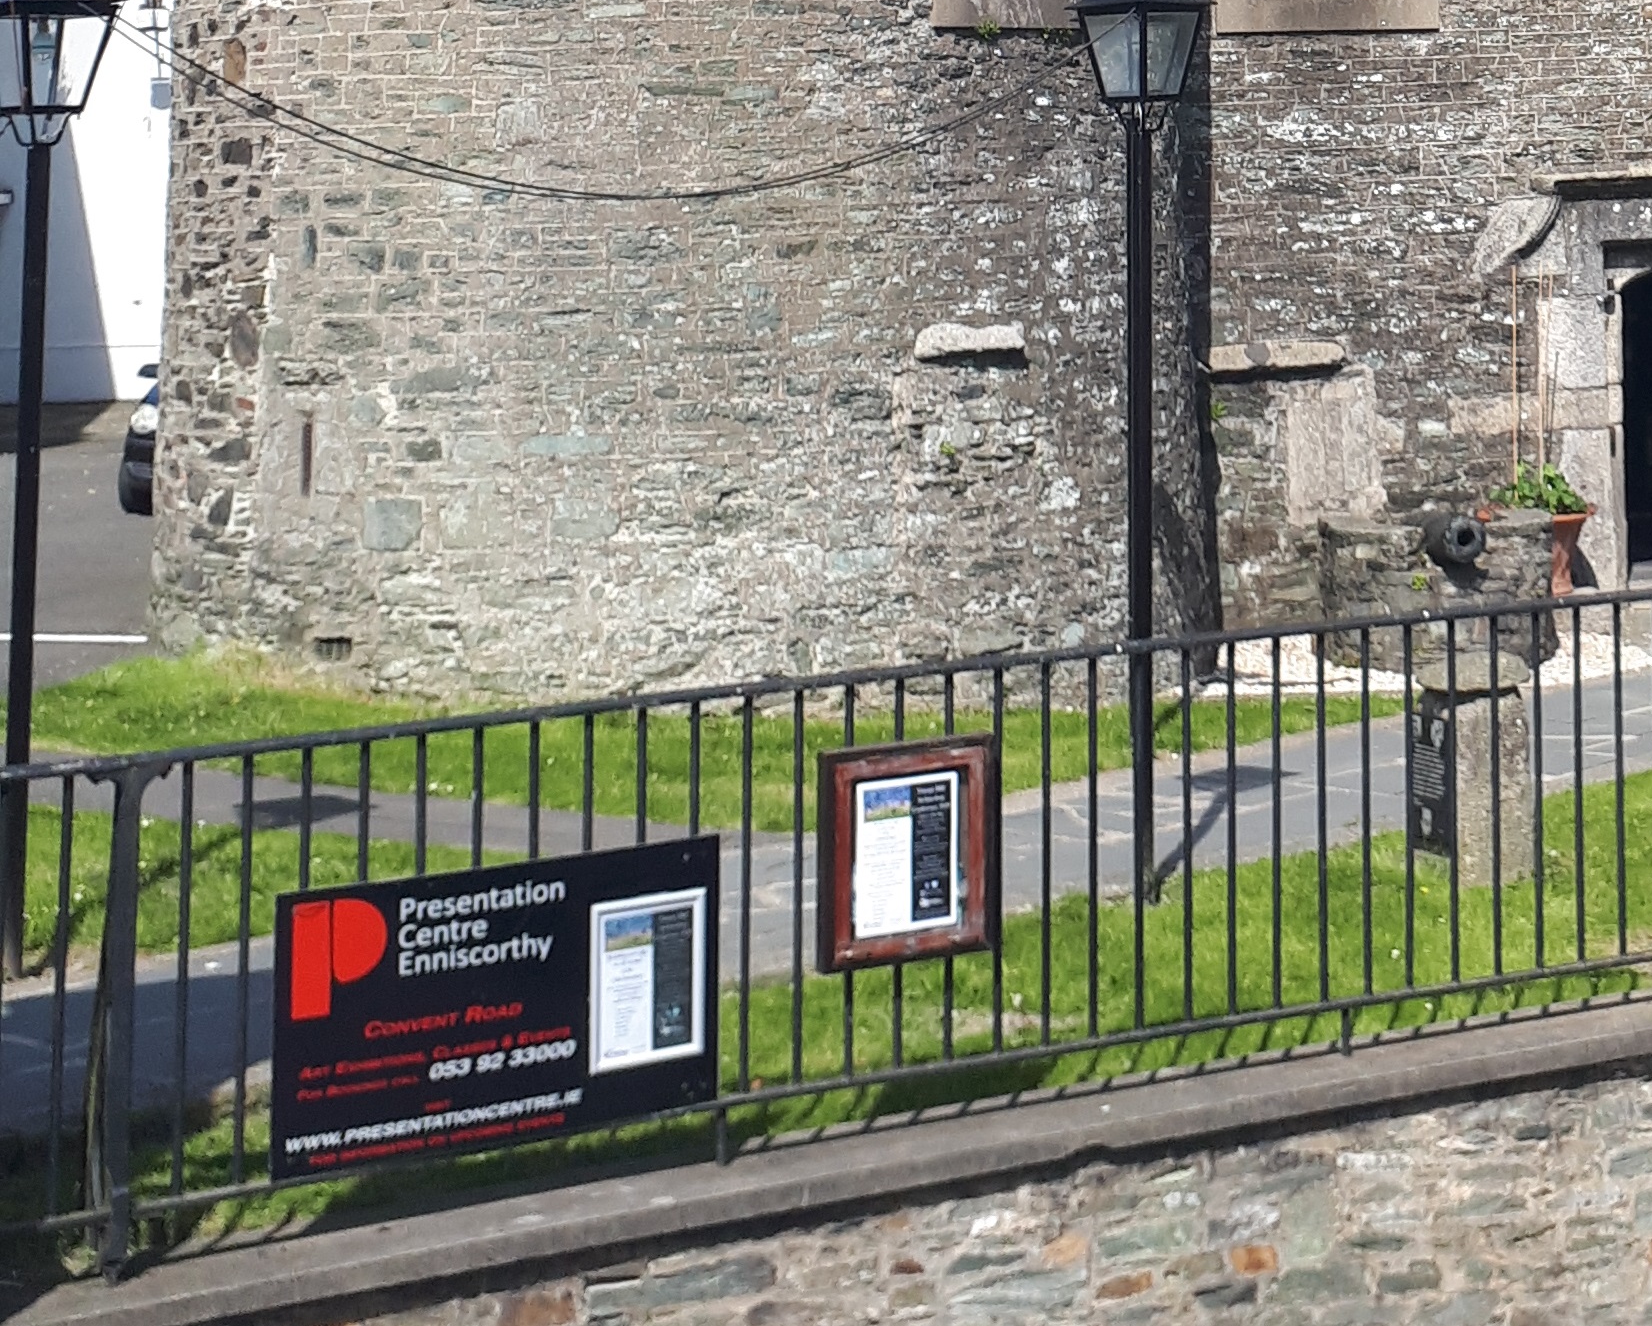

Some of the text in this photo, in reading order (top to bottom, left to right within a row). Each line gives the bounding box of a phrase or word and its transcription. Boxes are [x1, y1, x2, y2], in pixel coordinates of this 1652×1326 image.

[399, 879, 567, 924] Presentation
[398, 918, 490, 949] Centre
[398, 931, 554, 978] Enniscorthy
[429, 1057, 473, 1082] 053
[475, 1050, 507, 1074] 92
[508, 1038, 578, 1068] 33000
